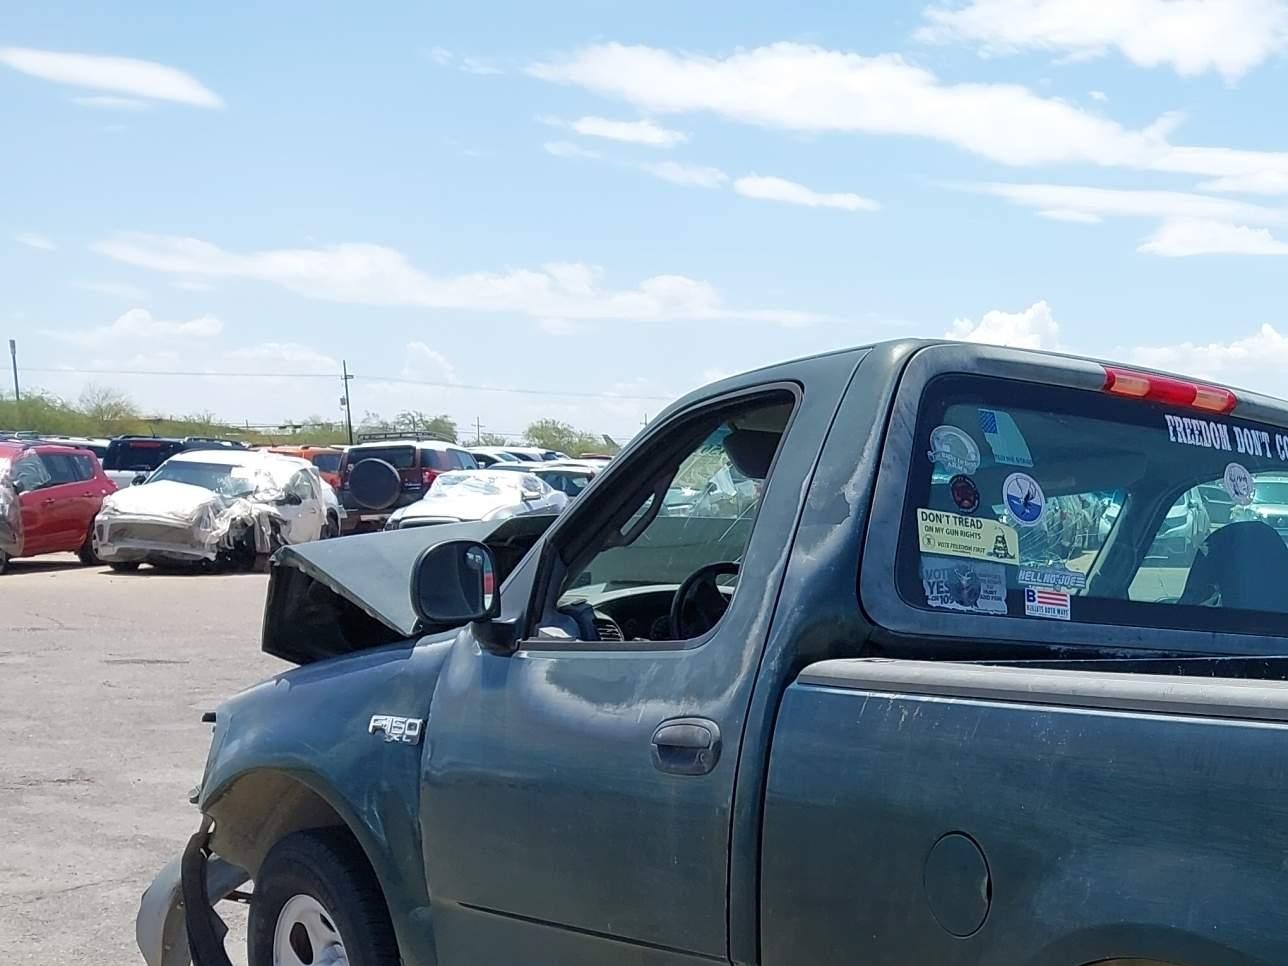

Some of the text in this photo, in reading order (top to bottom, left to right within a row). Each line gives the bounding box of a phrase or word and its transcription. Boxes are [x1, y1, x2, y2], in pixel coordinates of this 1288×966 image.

[1164, 414, 1232, 451] FREEDOM
[1233, 426, 1272, 458] DON'T
[921, 511, 983, 530] DON'T TREAD
[924, 525, 981, 540] ON MY GUN RIGHTS
[1018, 569, 1042, 582] HELL
[927, 580, 950, 595] YES
